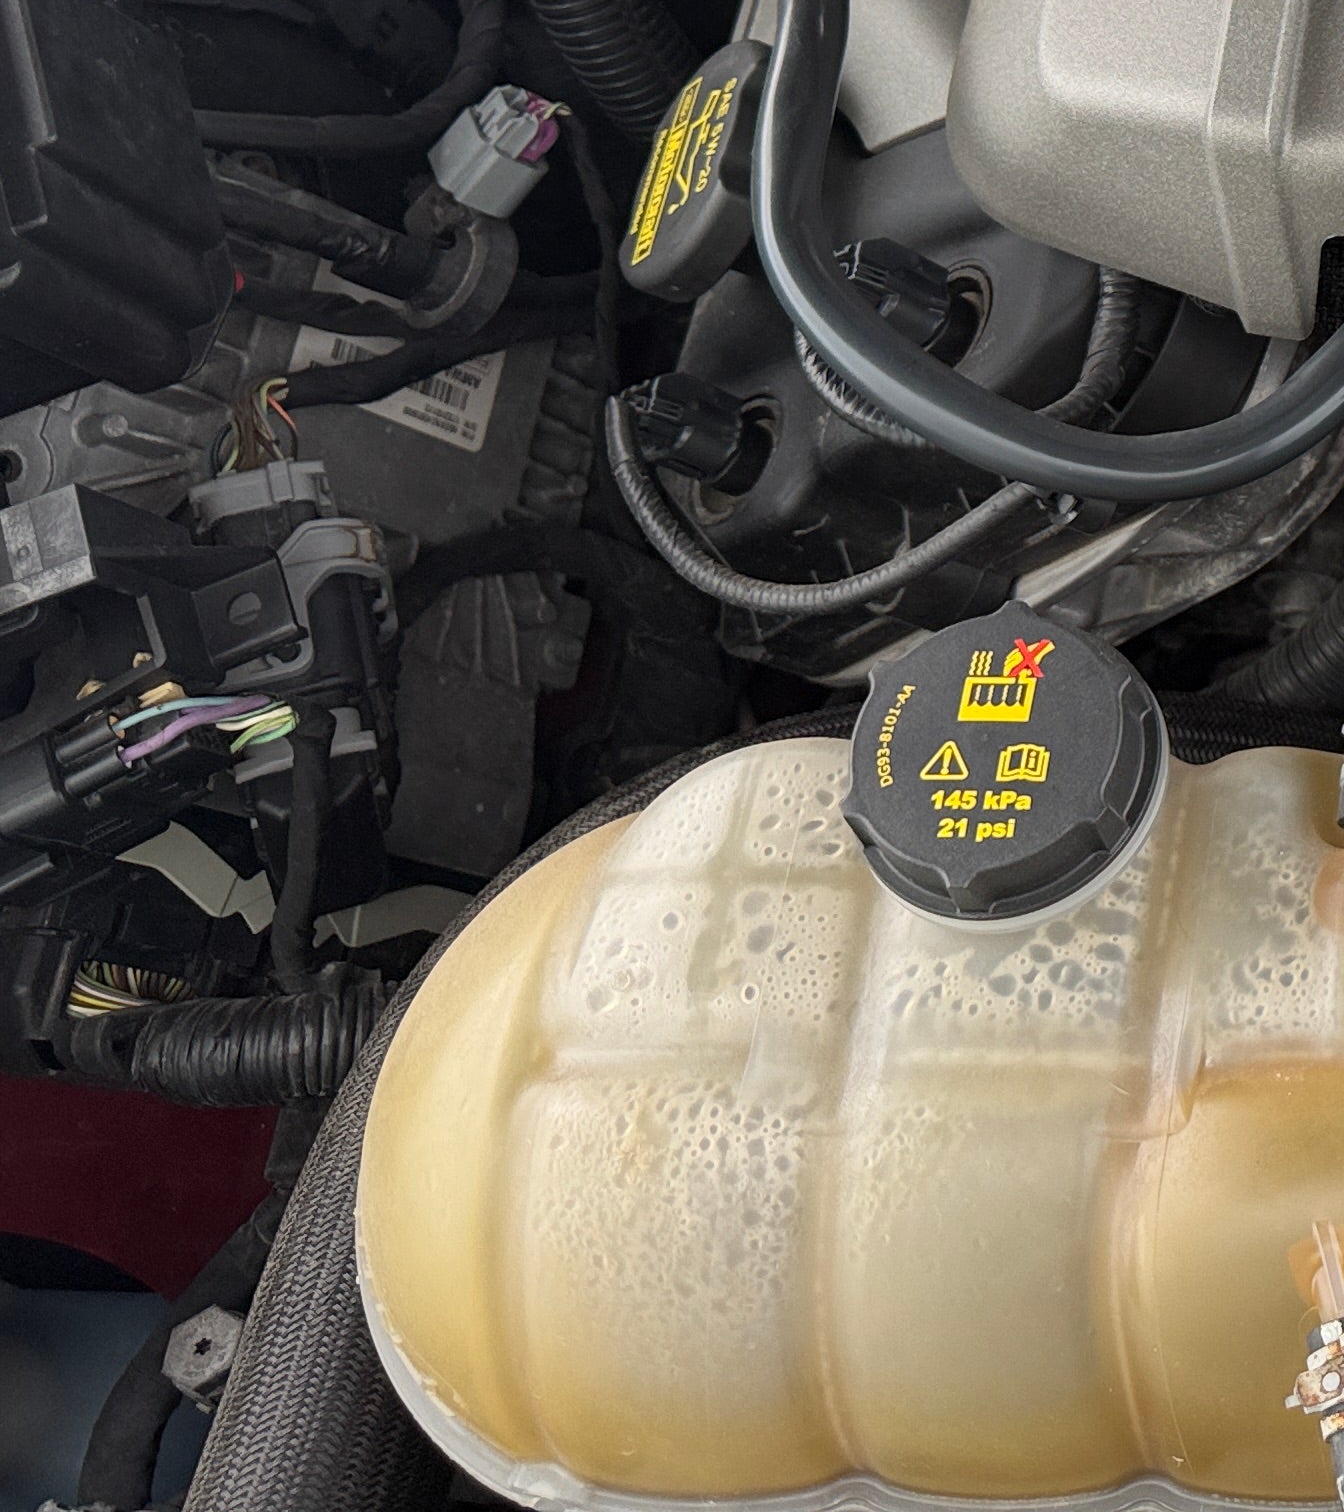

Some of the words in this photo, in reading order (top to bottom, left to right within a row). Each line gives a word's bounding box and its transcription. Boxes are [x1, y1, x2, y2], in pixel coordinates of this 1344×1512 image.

[716, 77, 738, 120] SAE
[695, 122, 724, 194] 5W-20
[876, 684, 916, 788] DG93-8101-AA
[931, 790, 977, 811] 145
[983, 790, 1032, 811] kPa
[937, 819, 968, 839] 21
[975, 818, 1017, 843] psi
